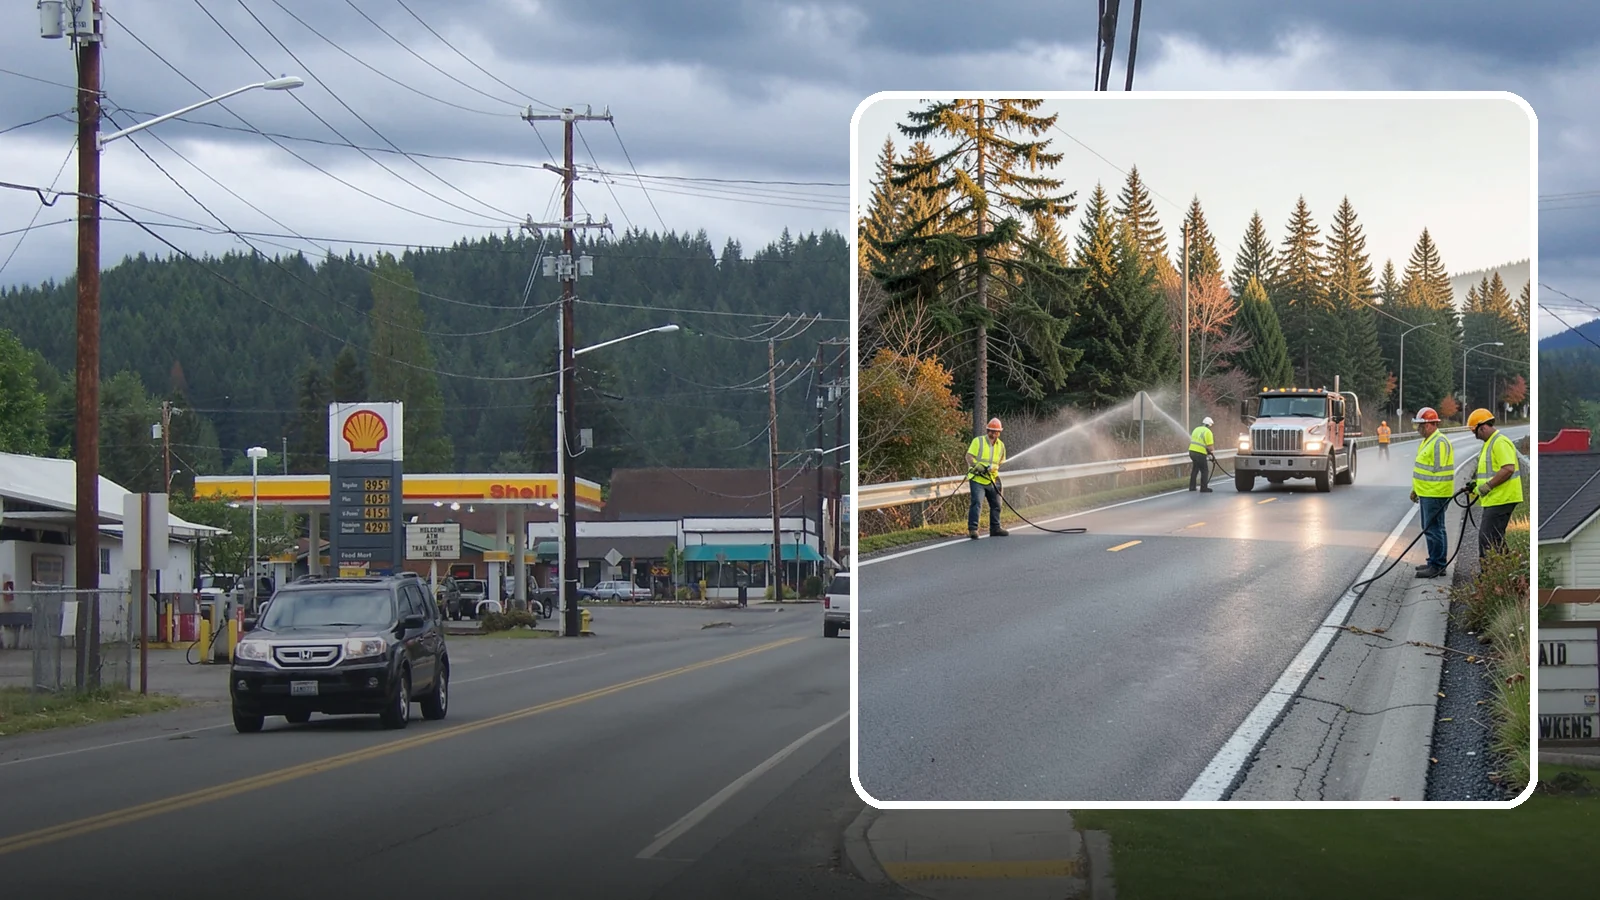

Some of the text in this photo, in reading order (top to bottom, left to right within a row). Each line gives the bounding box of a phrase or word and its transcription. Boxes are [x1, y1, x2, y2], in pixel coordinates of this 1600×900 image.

[366, 480, 383, 490] 395
[490, 485, 548, 499] Shell
[366, 494, 383, 504] 405
[366, 508, 383, 518] 415
[366, 522, 383, 532] 429
